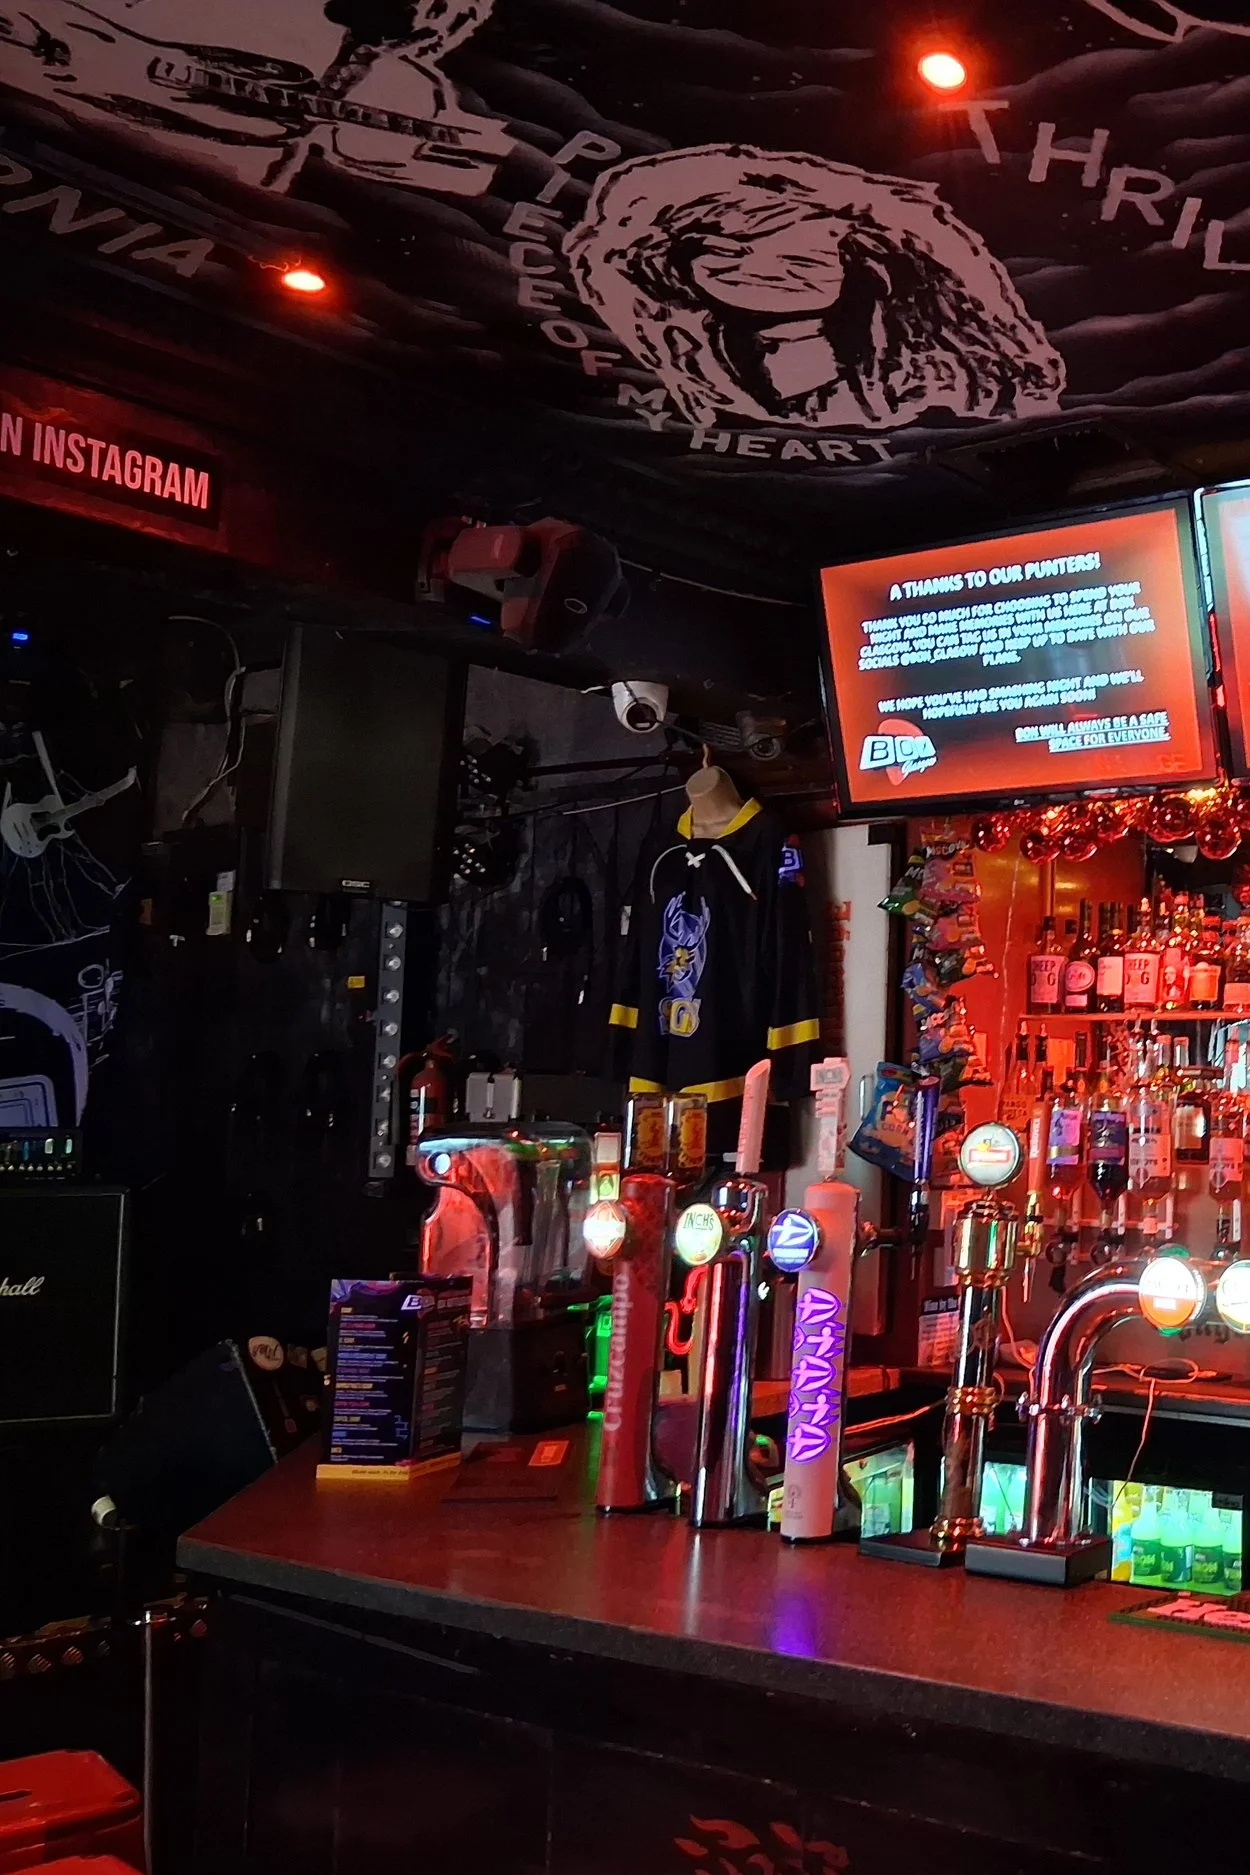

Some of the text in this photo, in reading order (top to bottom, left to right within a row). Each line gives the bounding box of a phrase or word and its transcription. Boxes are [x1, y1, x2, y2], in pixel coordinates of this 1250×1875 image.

[502, 130, 892, 464] PIECE OF MY HEART
[32, 422, 209, 509] INSTAGRAM
[890, 552, 1101, 601] A THANKS TO OUR PUNTERS!
[1015, 711, 1169, 741] BOX WILL ALWAYS BE A SAFE
[1049, 736, 1083, 751] SPACE
[1084, 732, 1107, 747] FOR
[603, 1272, 634, 1431] Cruzcampo
